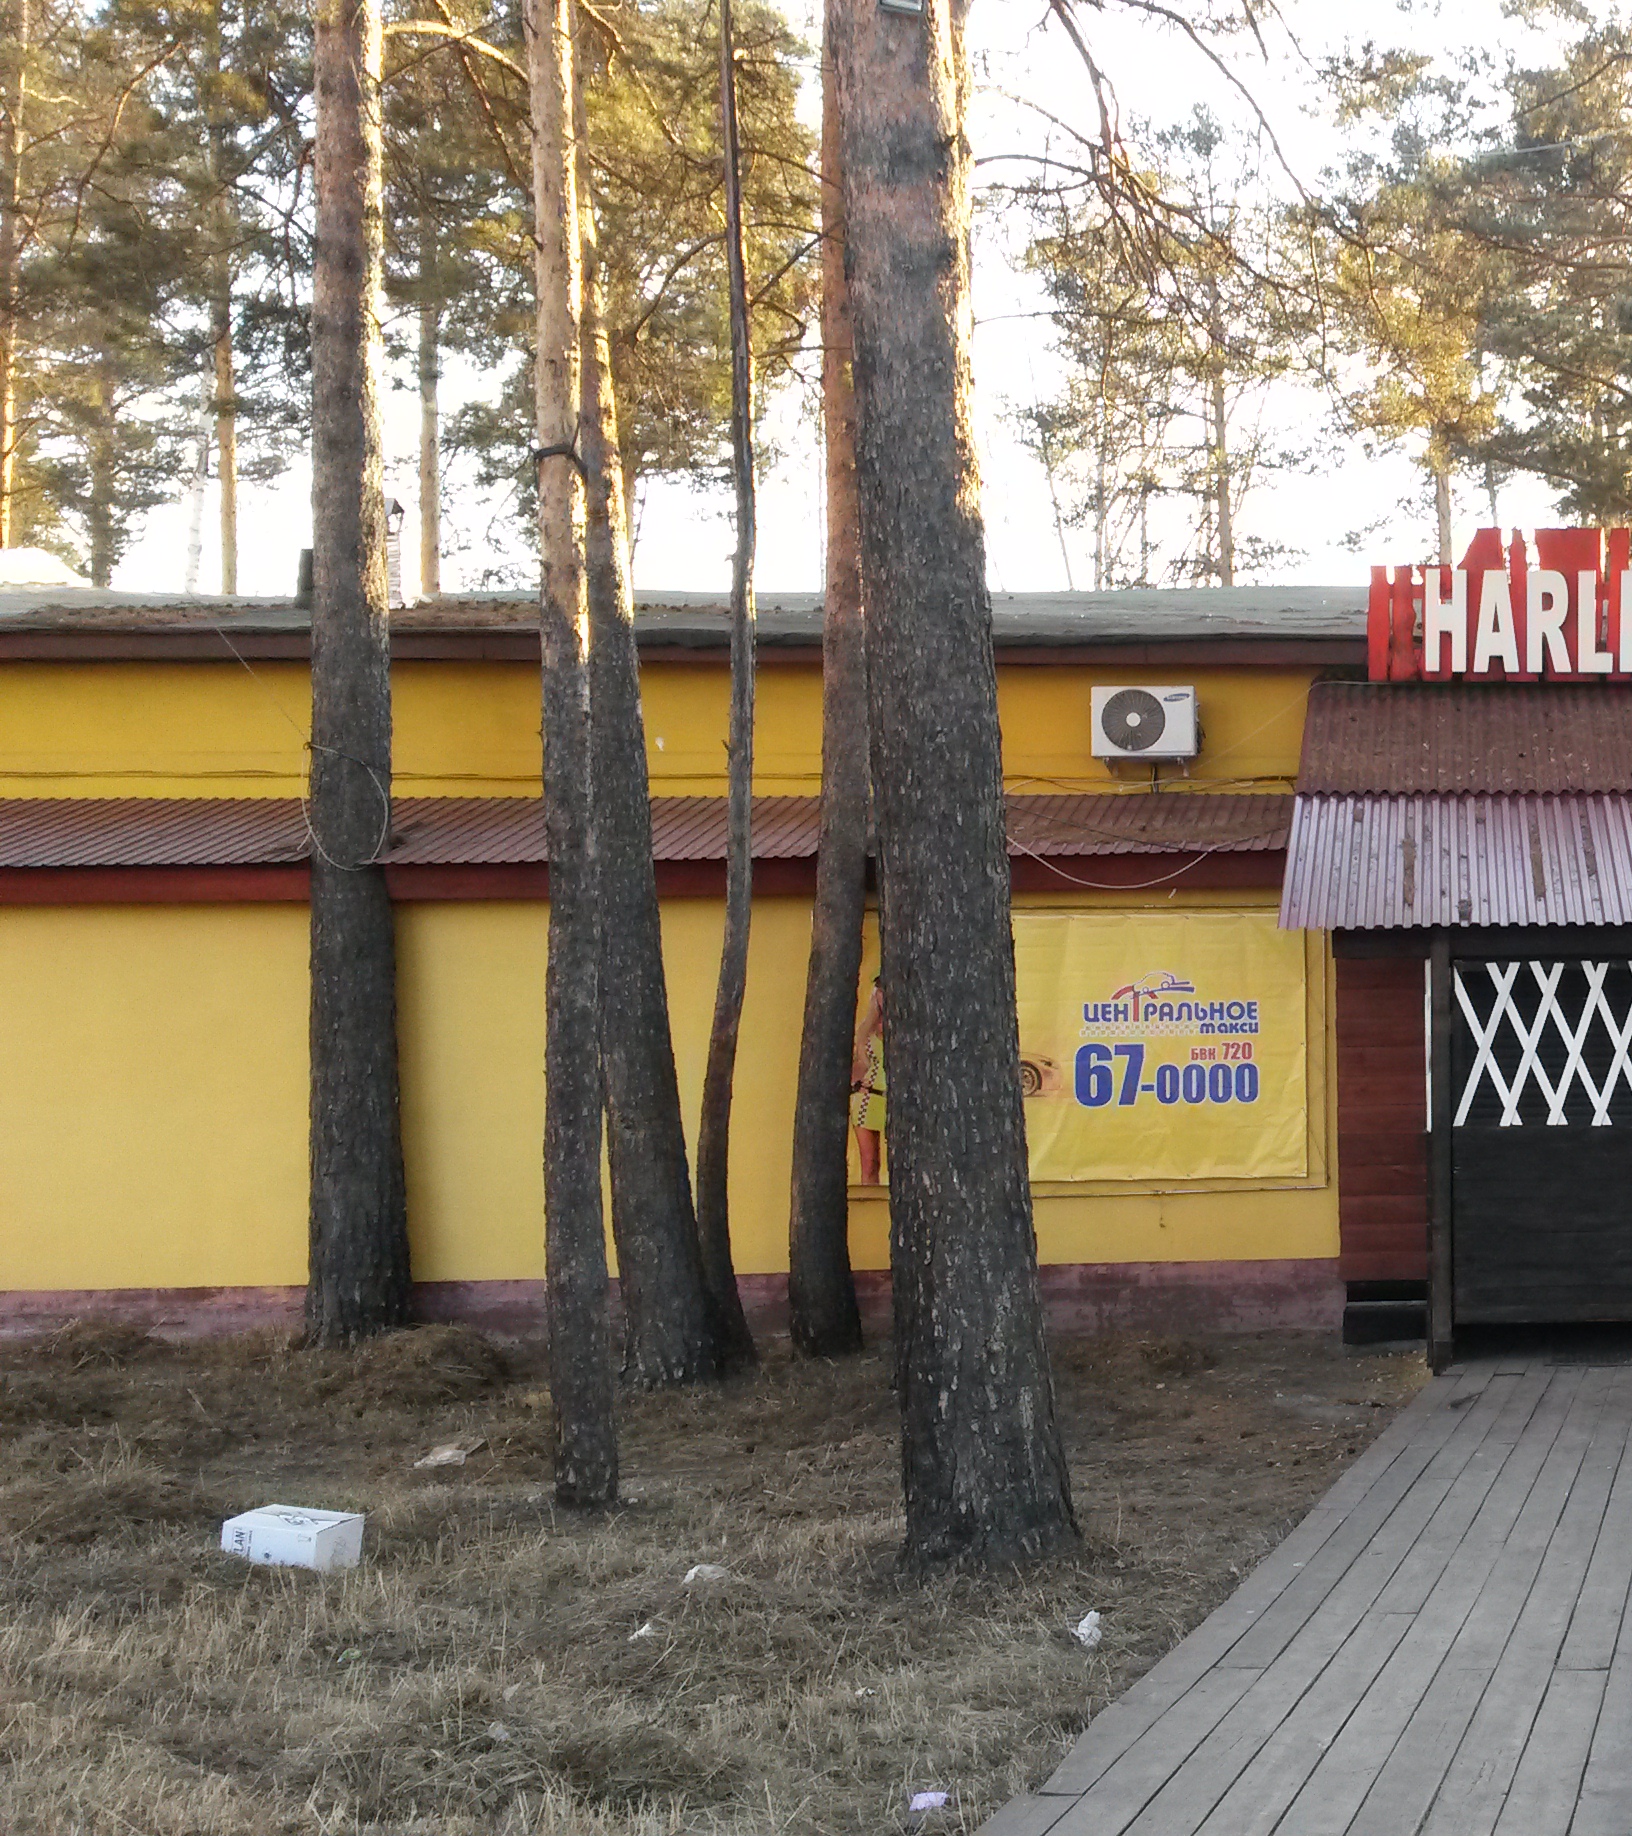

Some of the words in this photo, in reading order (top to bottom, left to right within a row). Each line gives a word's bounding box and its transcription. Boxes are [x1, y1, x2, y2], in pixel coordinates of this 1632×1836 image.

[1083, 994, 1258, 1022] ЦЕНТРАЛЬНОЕ
[1221, 1042, 1253, 1060] 720
[1075, 1043, 1259, 1107] 67-0000
